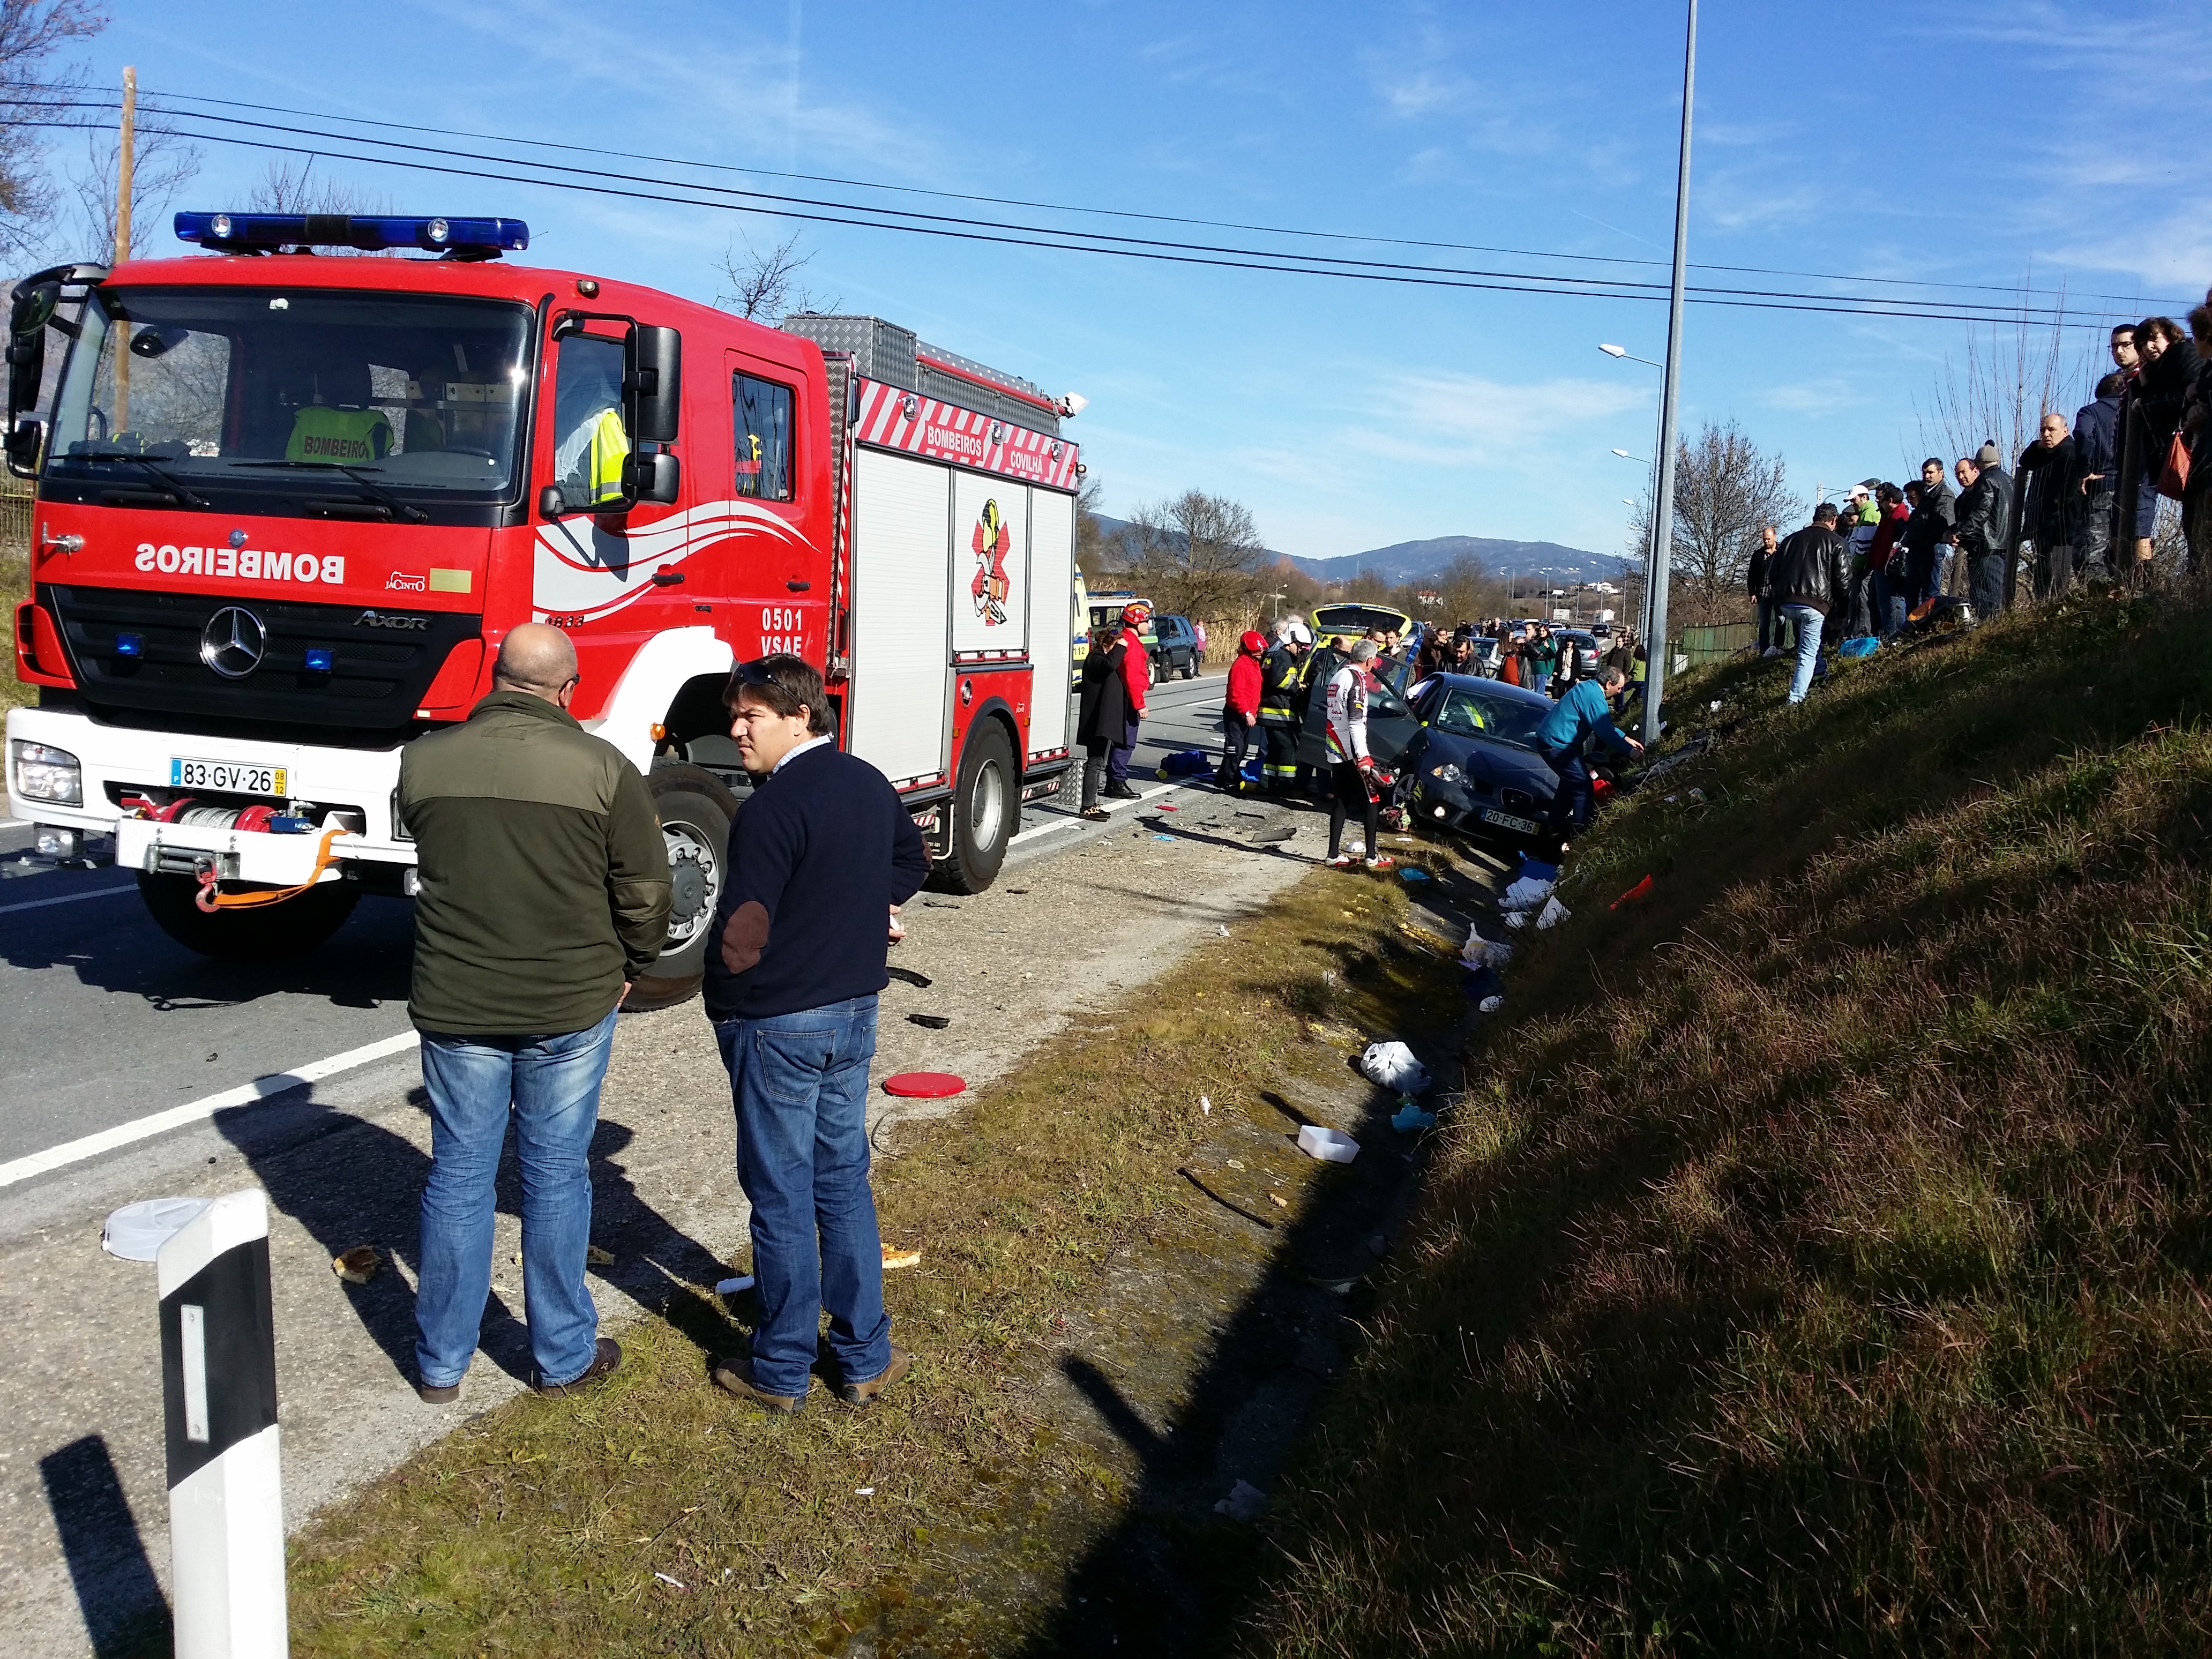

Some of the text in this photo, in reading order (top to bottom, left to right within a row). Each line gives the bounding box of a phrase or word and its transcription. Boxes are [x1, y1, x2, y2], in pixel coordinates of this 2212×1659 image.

[304, 436, 370, 459] BOMBEIRO
[928, 425, 982, 457] BOMBEIROS
[384, 579, 425, 592] JACINTO
[762, 607, 802, 631] 0501
[760, 636, 802, 658] VSAE
[275, 772, 285, 780] 08
[275, 786, 284, 794] 12
